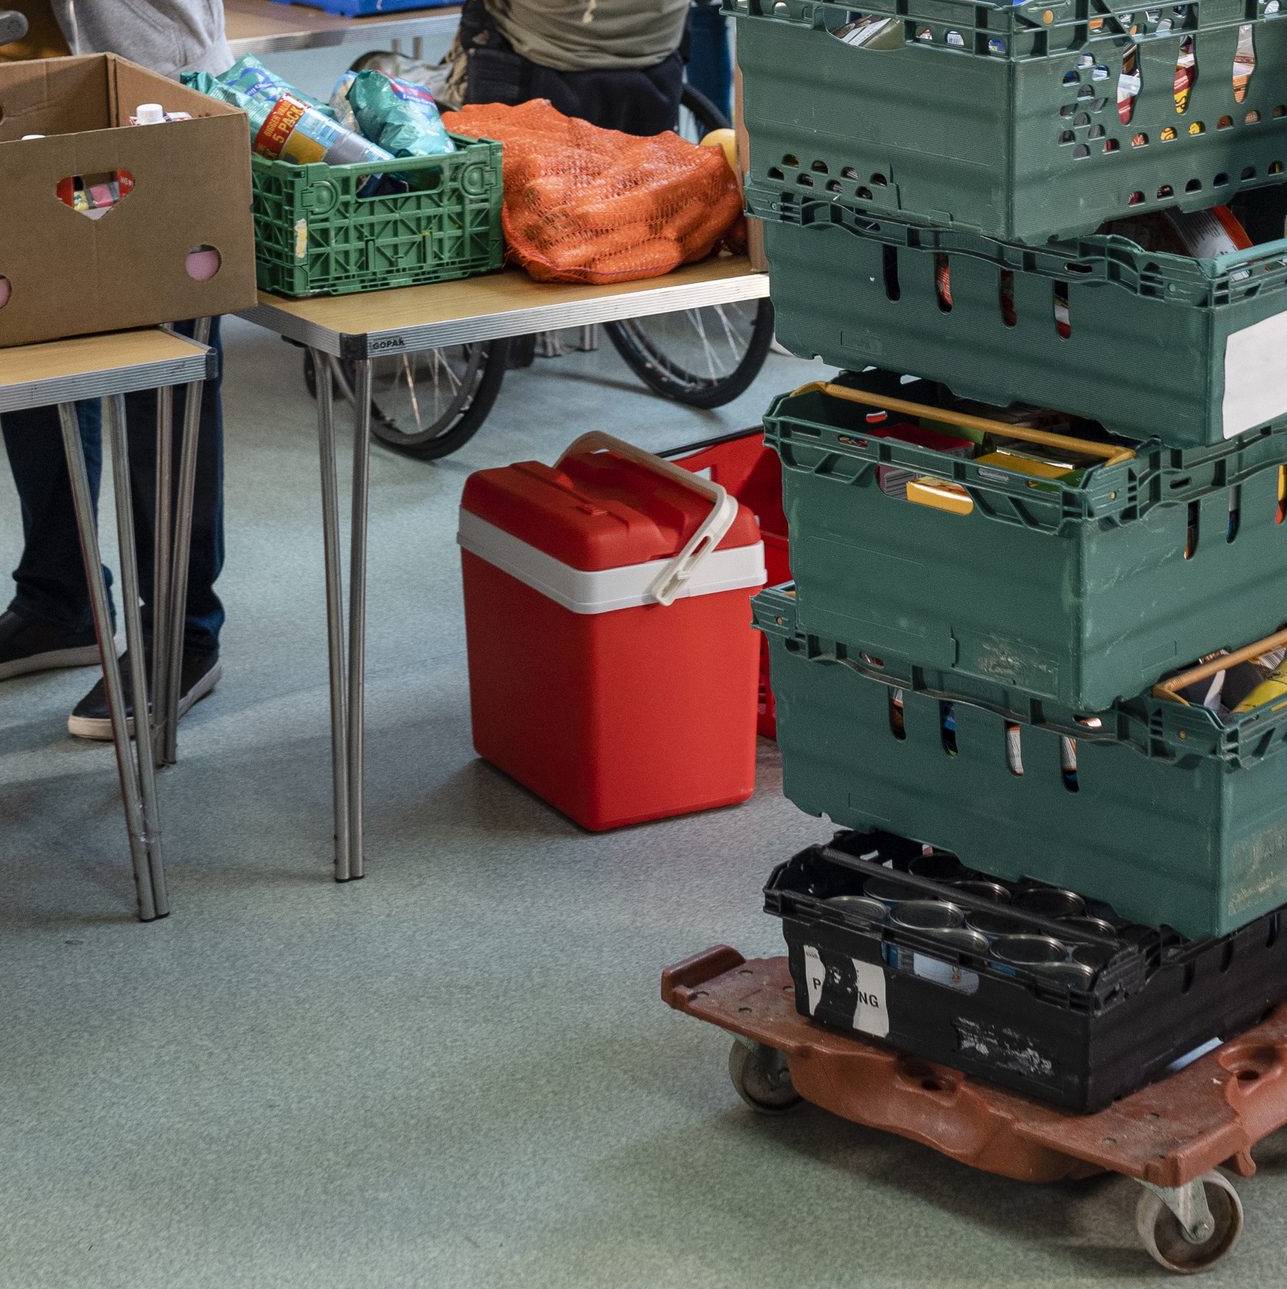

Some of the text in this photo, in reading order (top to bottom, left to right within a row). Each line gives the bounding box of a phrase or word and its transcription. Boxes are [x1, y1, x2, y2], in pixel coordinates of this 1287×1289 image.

[264, 113, 281, 136] BIGGER
[272, 105, 304, 143] 5 PACK
[373, 337, 405, 349] GOPAK
